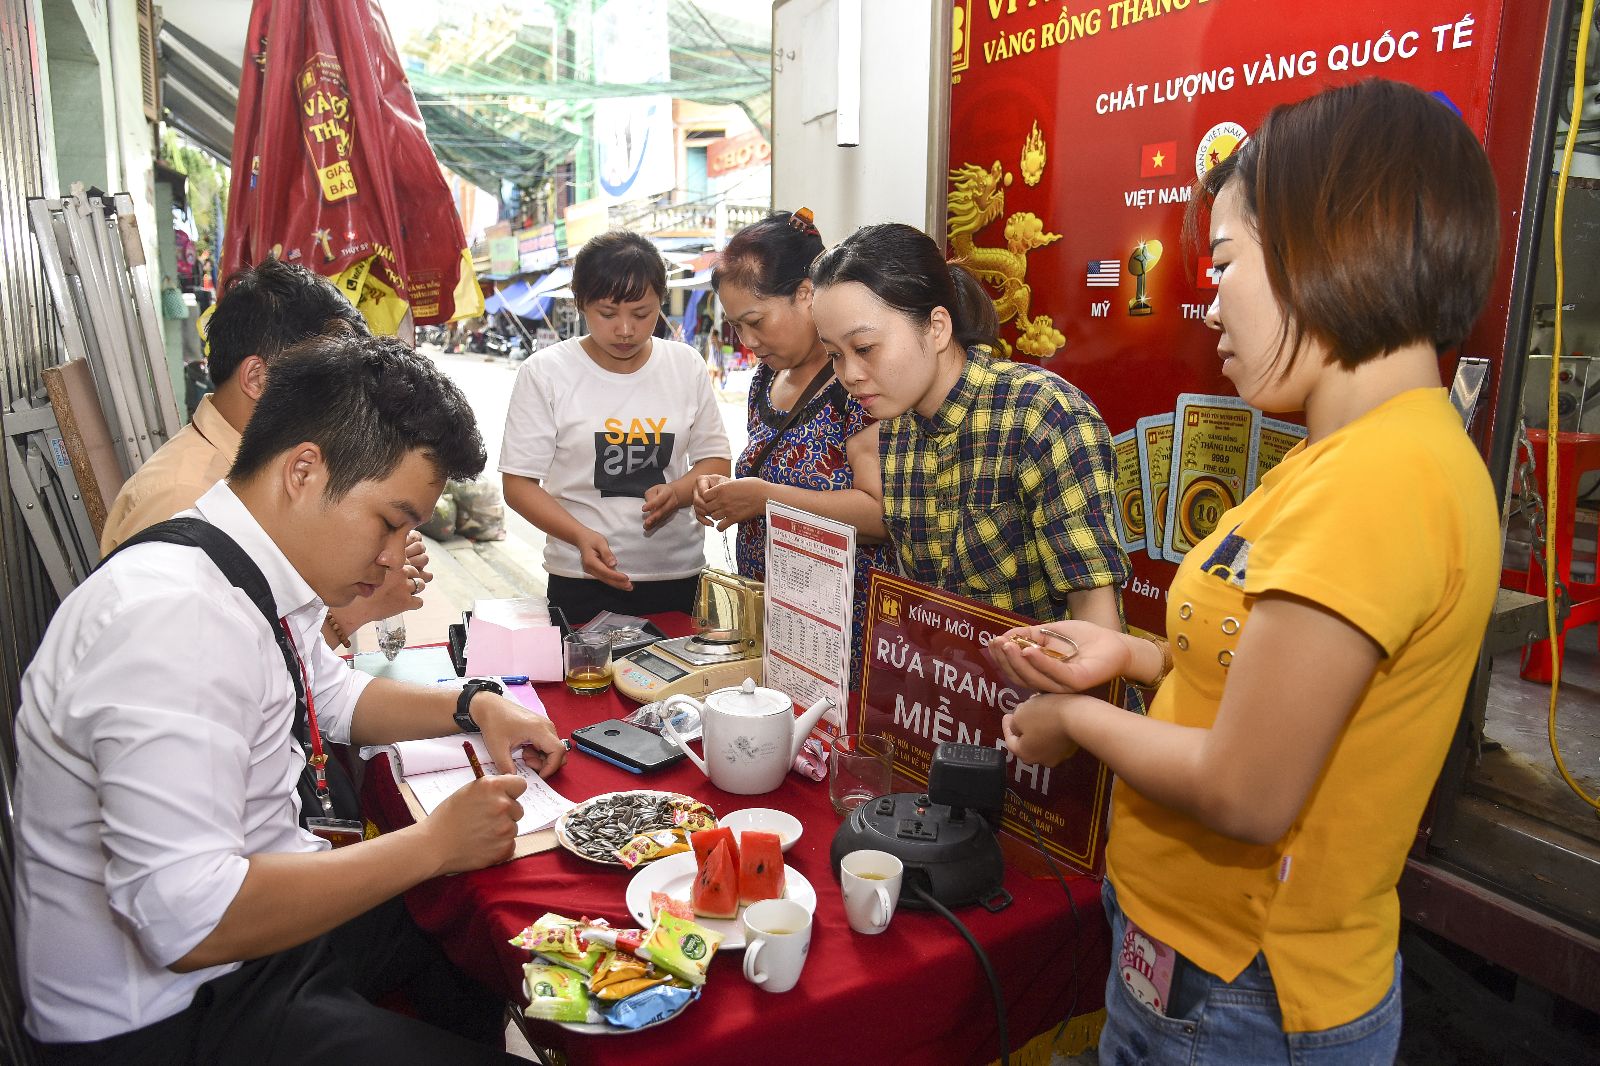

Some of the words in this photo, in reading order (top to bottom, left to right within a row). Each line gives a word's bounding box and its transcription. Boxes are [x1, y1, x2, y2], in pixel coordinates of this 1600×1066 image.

[983, 28, 1036, 64] VÀNG
[1041, 5, 1102, 48] RỒNG
[1096, 83, 1149, 115] CHẤT
[1153, 66, 1235, 104] LƯỢNG
[1243, 50, 1317, 86] VÀNG
[1327, 30, 1419, 71] QUỐC
[1432, 13, 1475, 52] TẾ
[1124, 188, 1156, 210] VIỆT
[1158, 185, 1192, 204] NAM
[1091, 300, 1111, 318] MỸ
[604, 417, 667, 445] SAY
[1197, 504, 1218, 523] 10
[1131, 576, 1160, 600] bản
[908, 604, 941, 629] KÍNH
[944, 617, 975, 641] MỜI
[877, 635, 925, 679] RỬA
[932, 658, 1021, 715] TRANG
